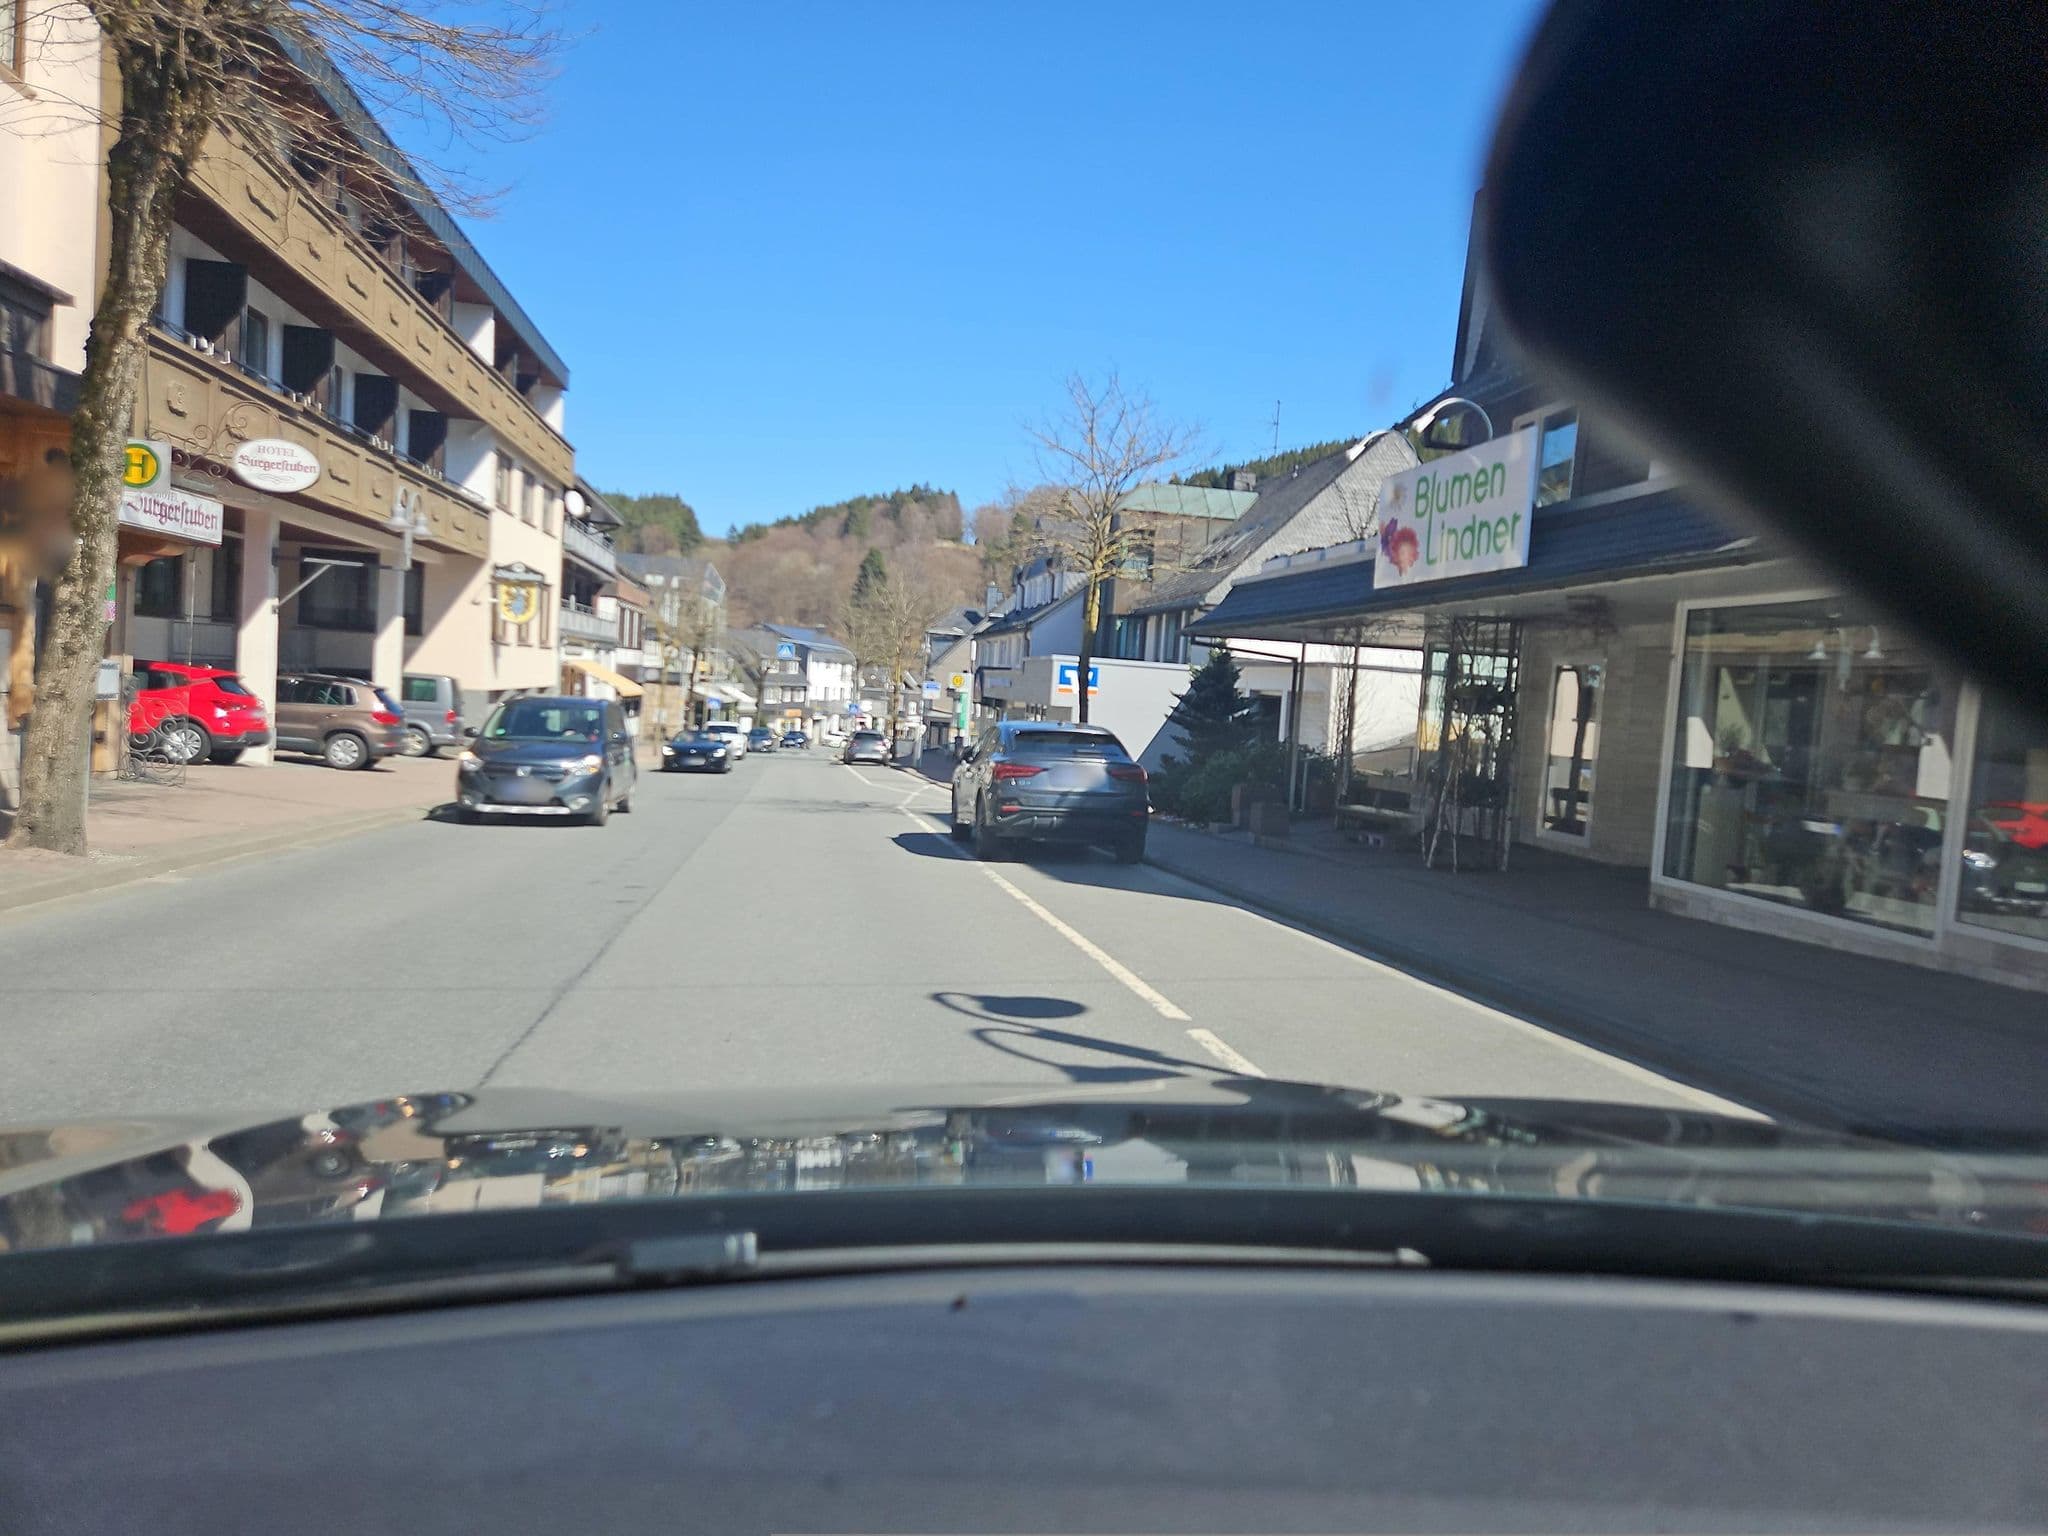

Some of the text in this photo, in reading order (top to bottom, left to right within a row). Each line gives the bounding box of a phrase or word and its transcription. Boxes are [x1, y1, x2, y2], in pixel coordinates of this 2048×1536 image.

[125, 453, 148, 478] H
[256, 444, 298, 458] HOTEL
[1415, 462, 1506, 518] Blumen
[1425, 512, 1521, 566] Lindner
